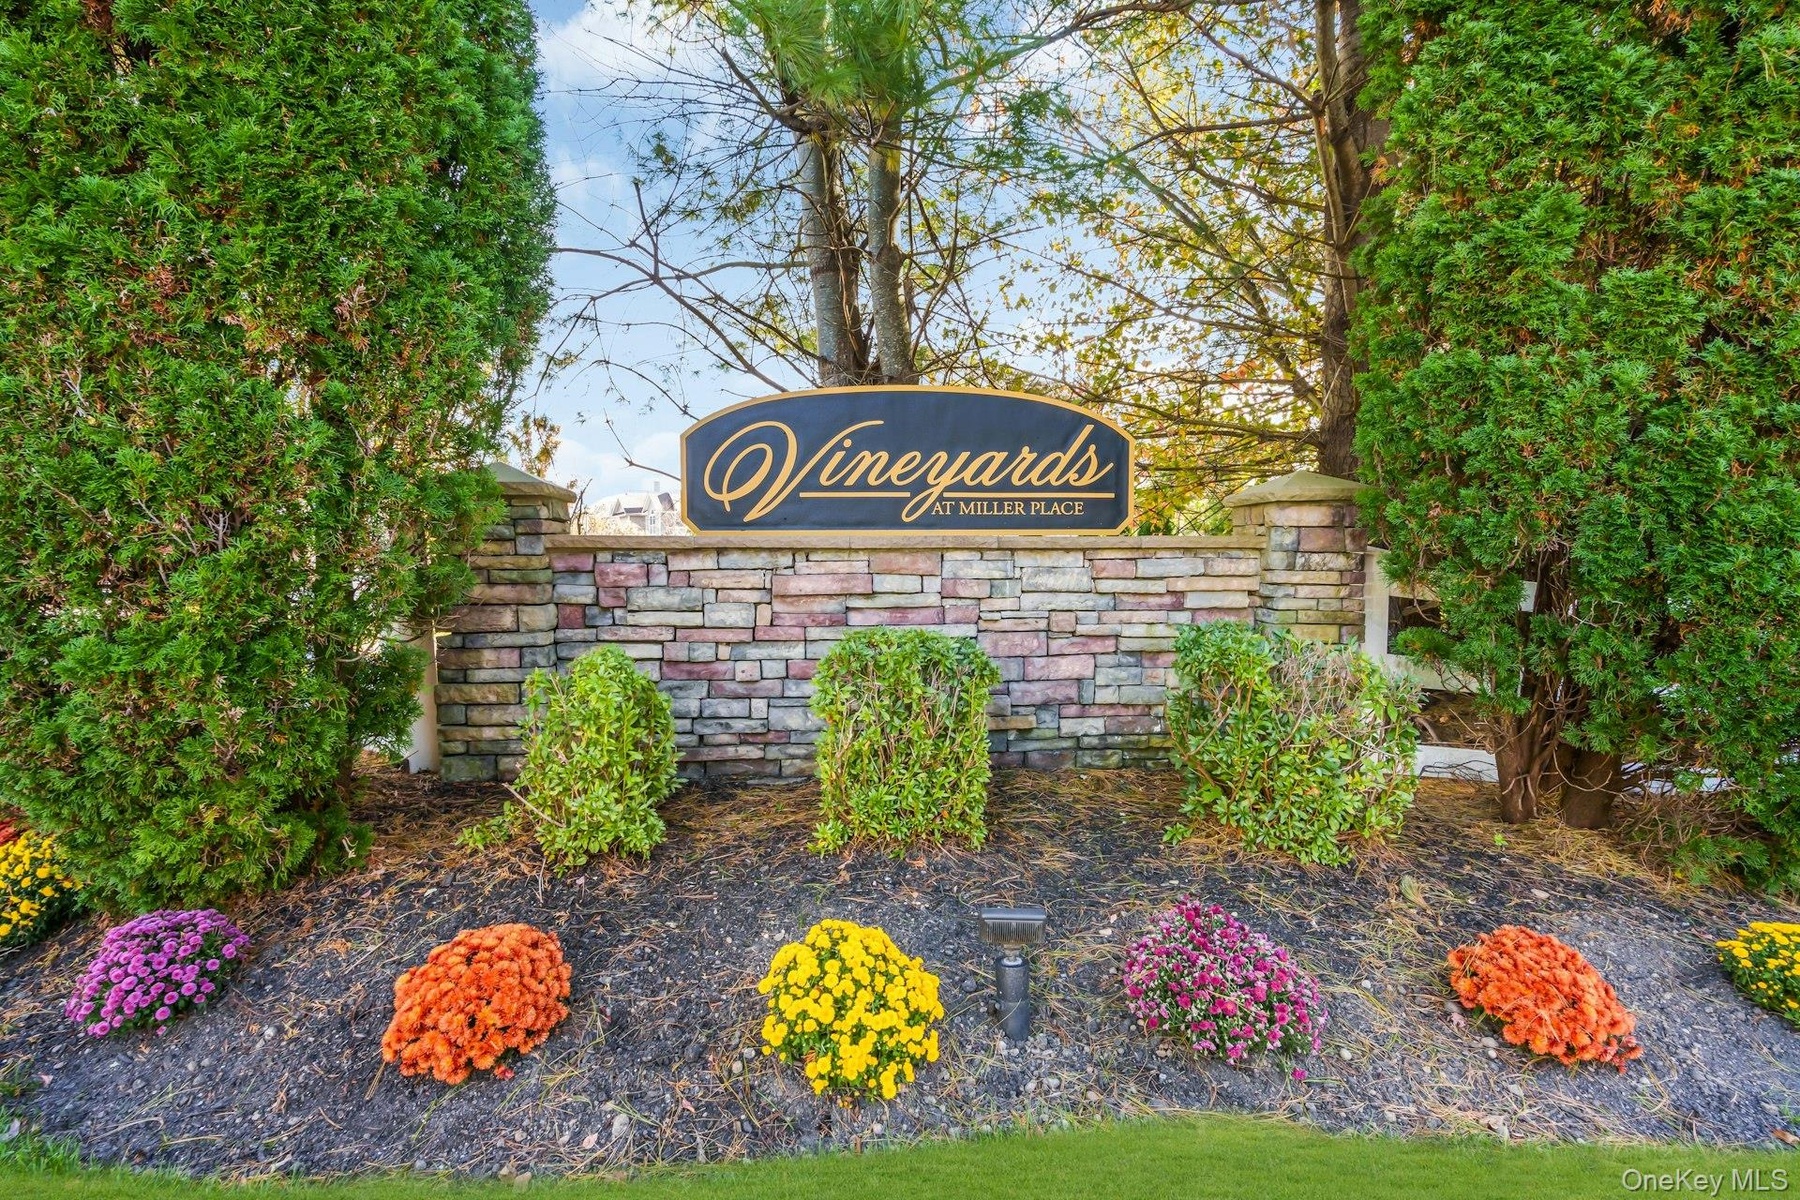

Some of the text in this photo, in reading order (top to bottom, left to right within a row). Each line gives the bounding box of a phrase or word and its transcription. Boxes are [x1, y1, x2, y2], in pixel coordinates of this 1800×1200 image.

[704, 420, 1114, 523] Vineyards
[931, 501, 1085, 516] AT MILLER PLACE
